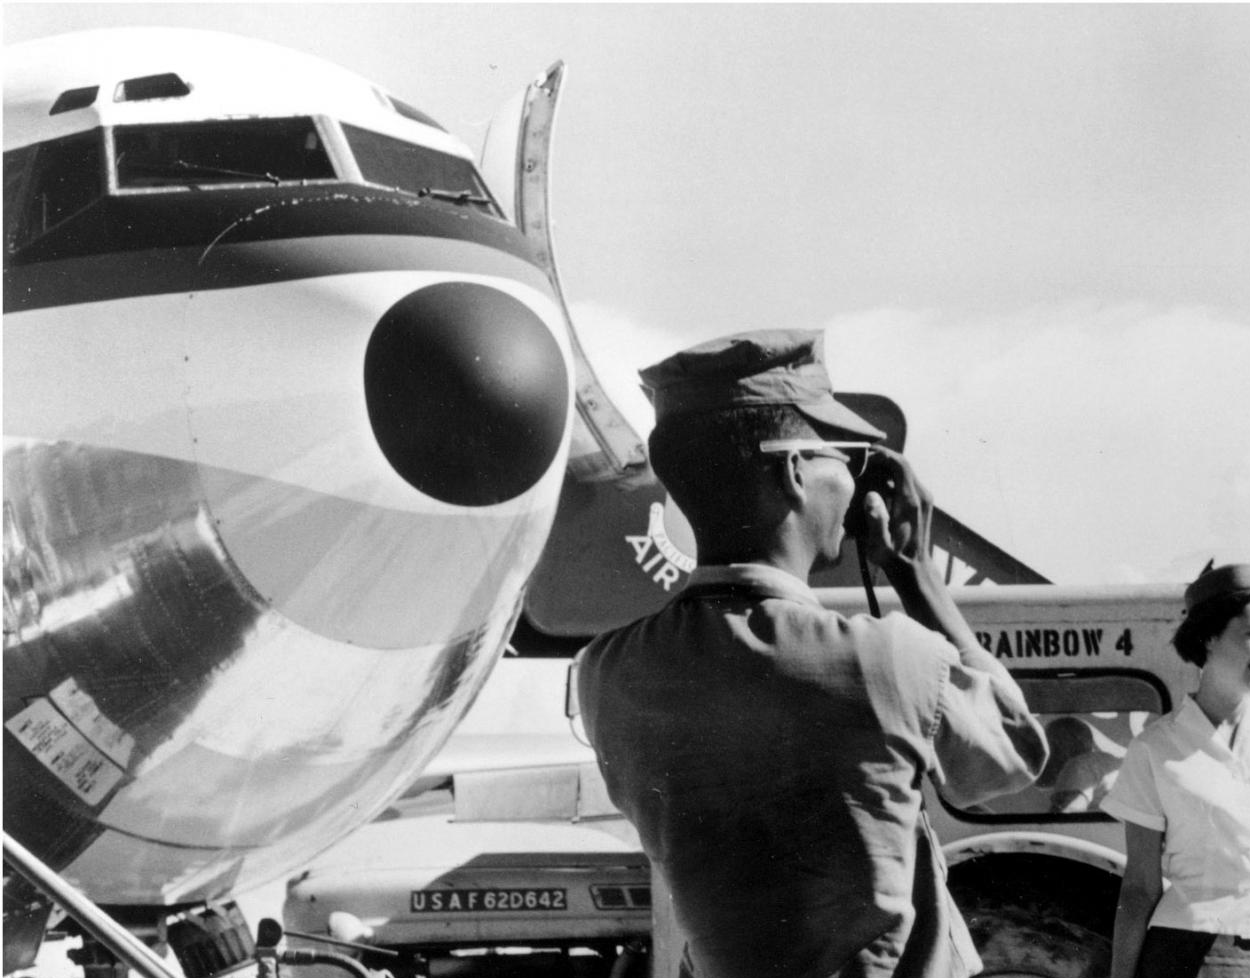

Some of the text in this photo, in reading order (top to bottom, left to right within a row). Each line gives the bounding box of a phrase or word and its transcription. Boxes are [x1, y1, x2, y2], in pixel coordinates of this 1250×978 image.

[624, 535, 680, 592] AIR
[974, 628, 1134, 658] RAINBOW 4
[483, 891, 565, 909] 62D642
